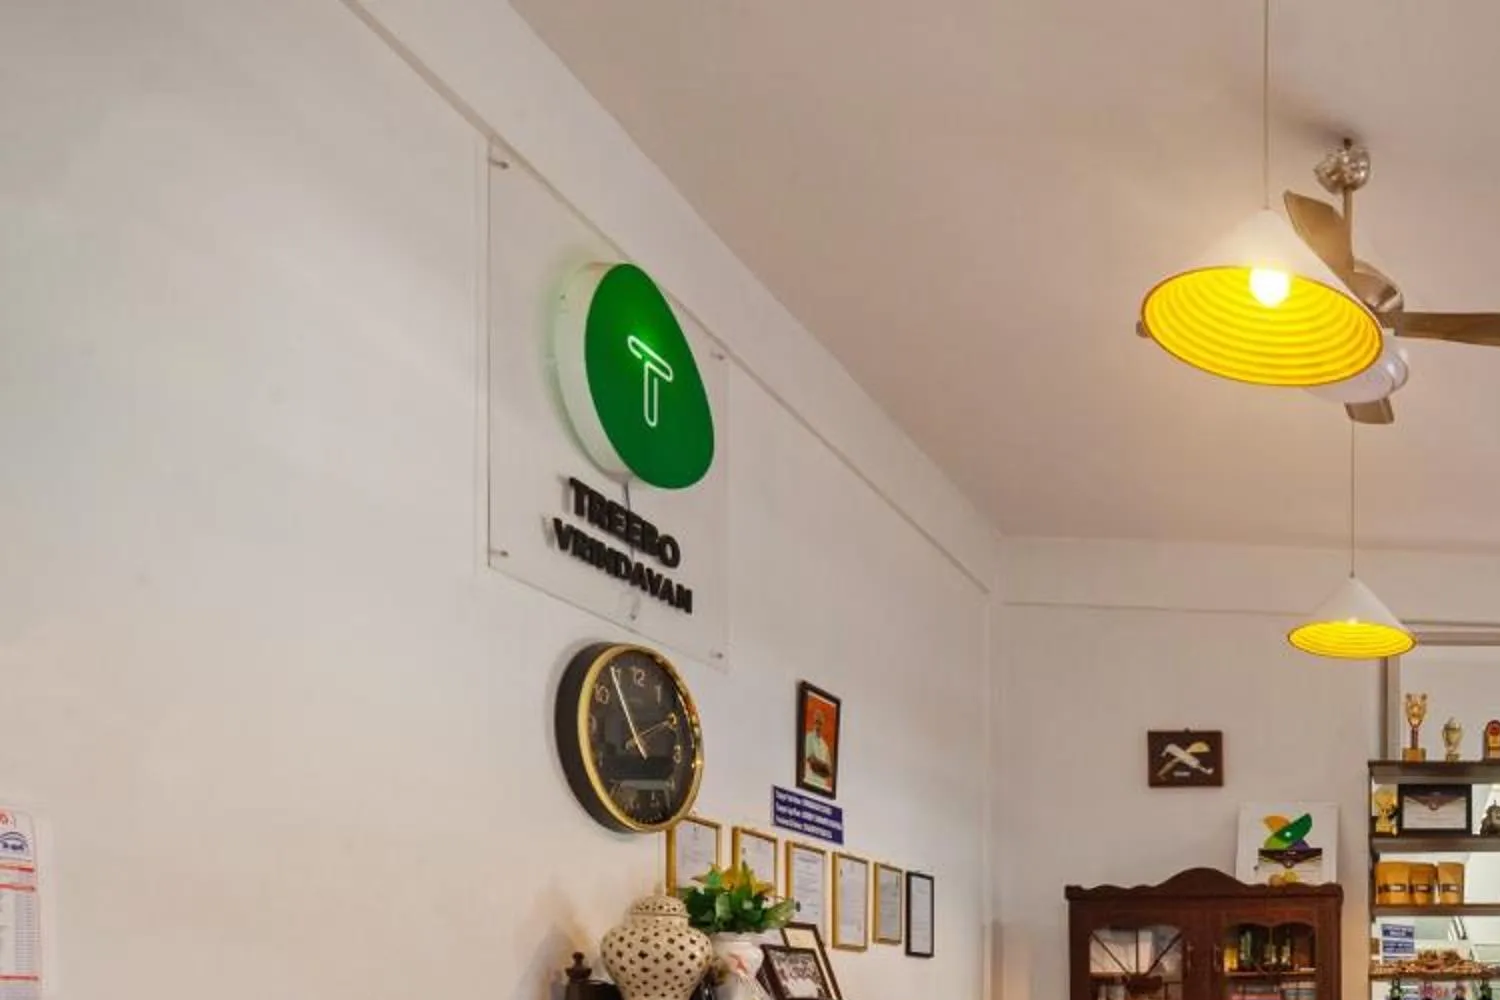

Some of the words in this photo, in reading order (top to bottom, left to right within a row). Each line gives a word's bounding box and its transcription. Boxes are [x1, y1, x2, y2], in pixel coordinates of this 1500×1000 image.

[551, 517, 693, 614] VRINDAVAN
[569, 476, 681, 569] TREEBO
[632, 666, 646, 686] 12
